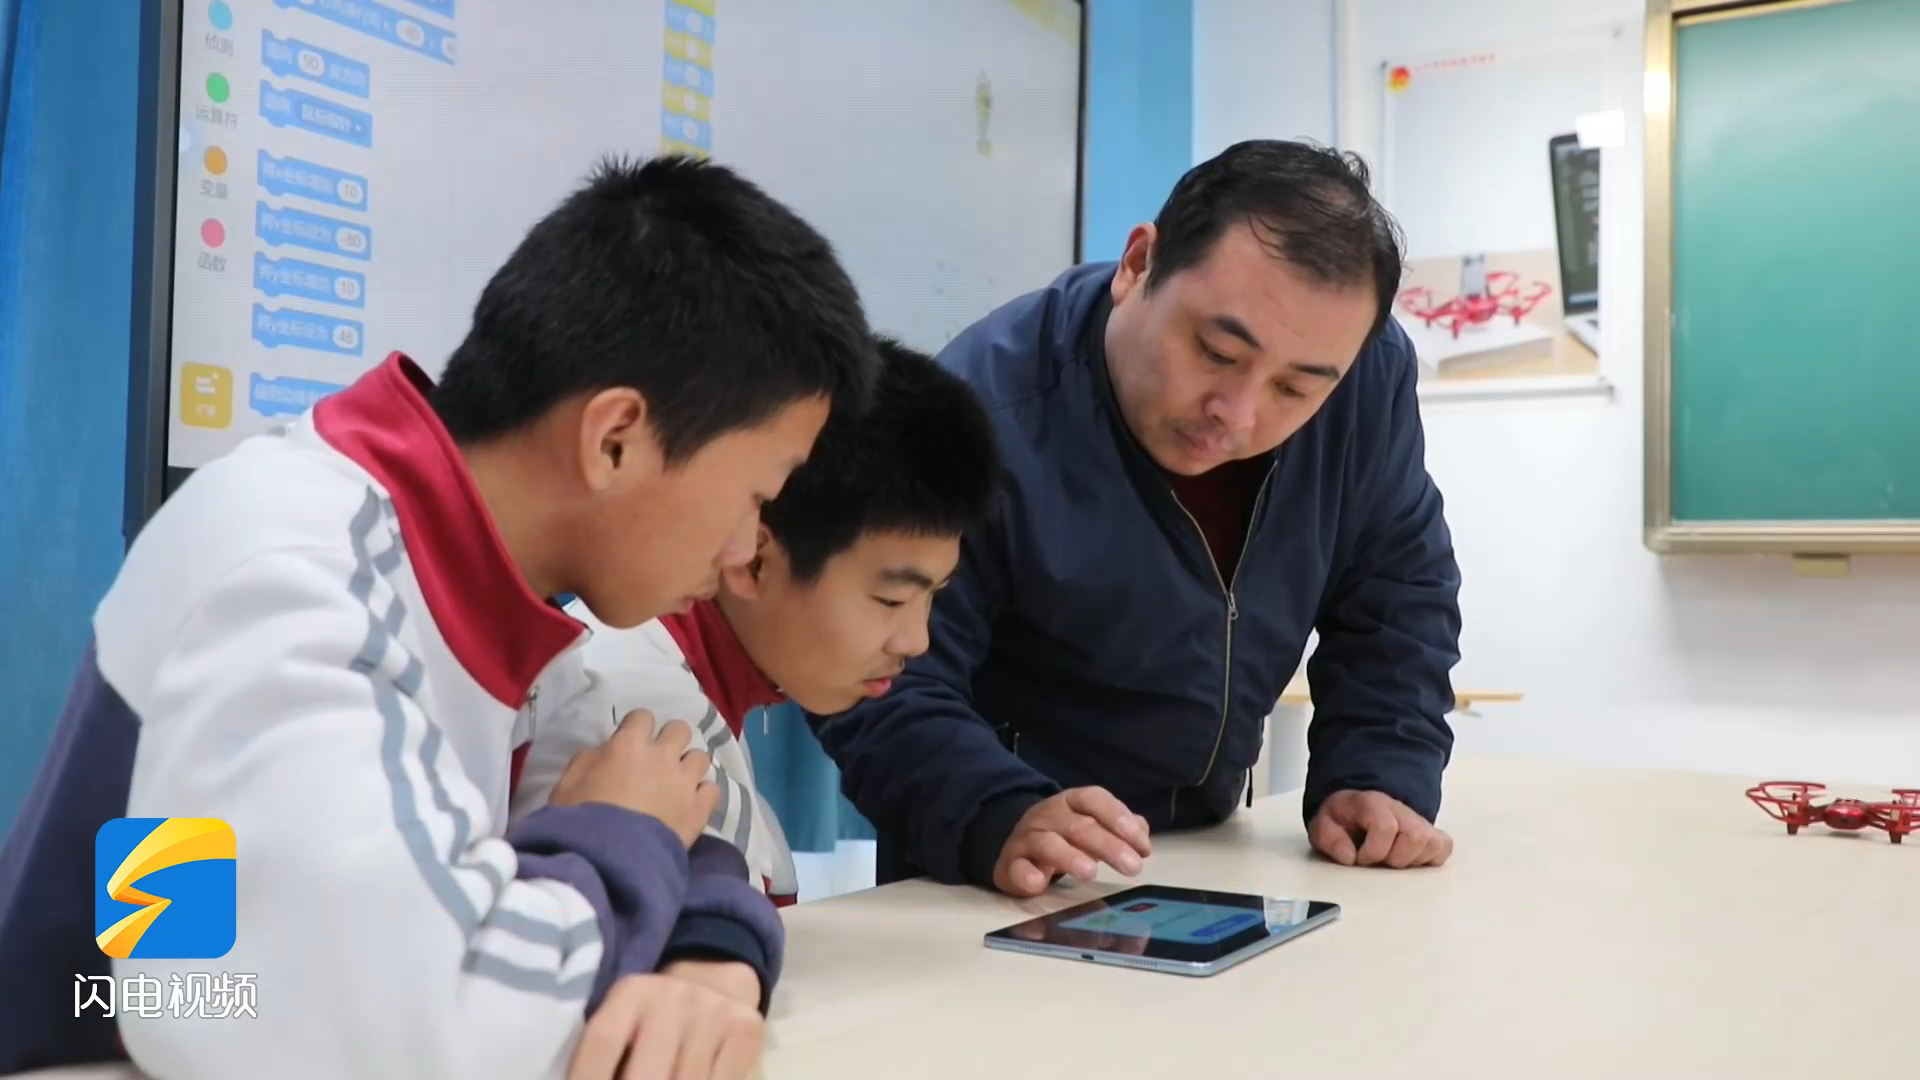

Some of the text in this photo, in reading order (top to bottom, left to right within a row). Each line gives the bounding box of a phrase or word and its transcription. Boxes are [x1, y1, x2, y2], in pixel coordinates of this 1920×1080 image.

[303, 53, 320, 71] 90
[195, 105, 237, 129] 运算符
[200, 178, 228, 200] 变量
[344, 183, 358, 200] 10
[197, 250, 227, 272] 函数
[341, 279, 355, 296] 10
